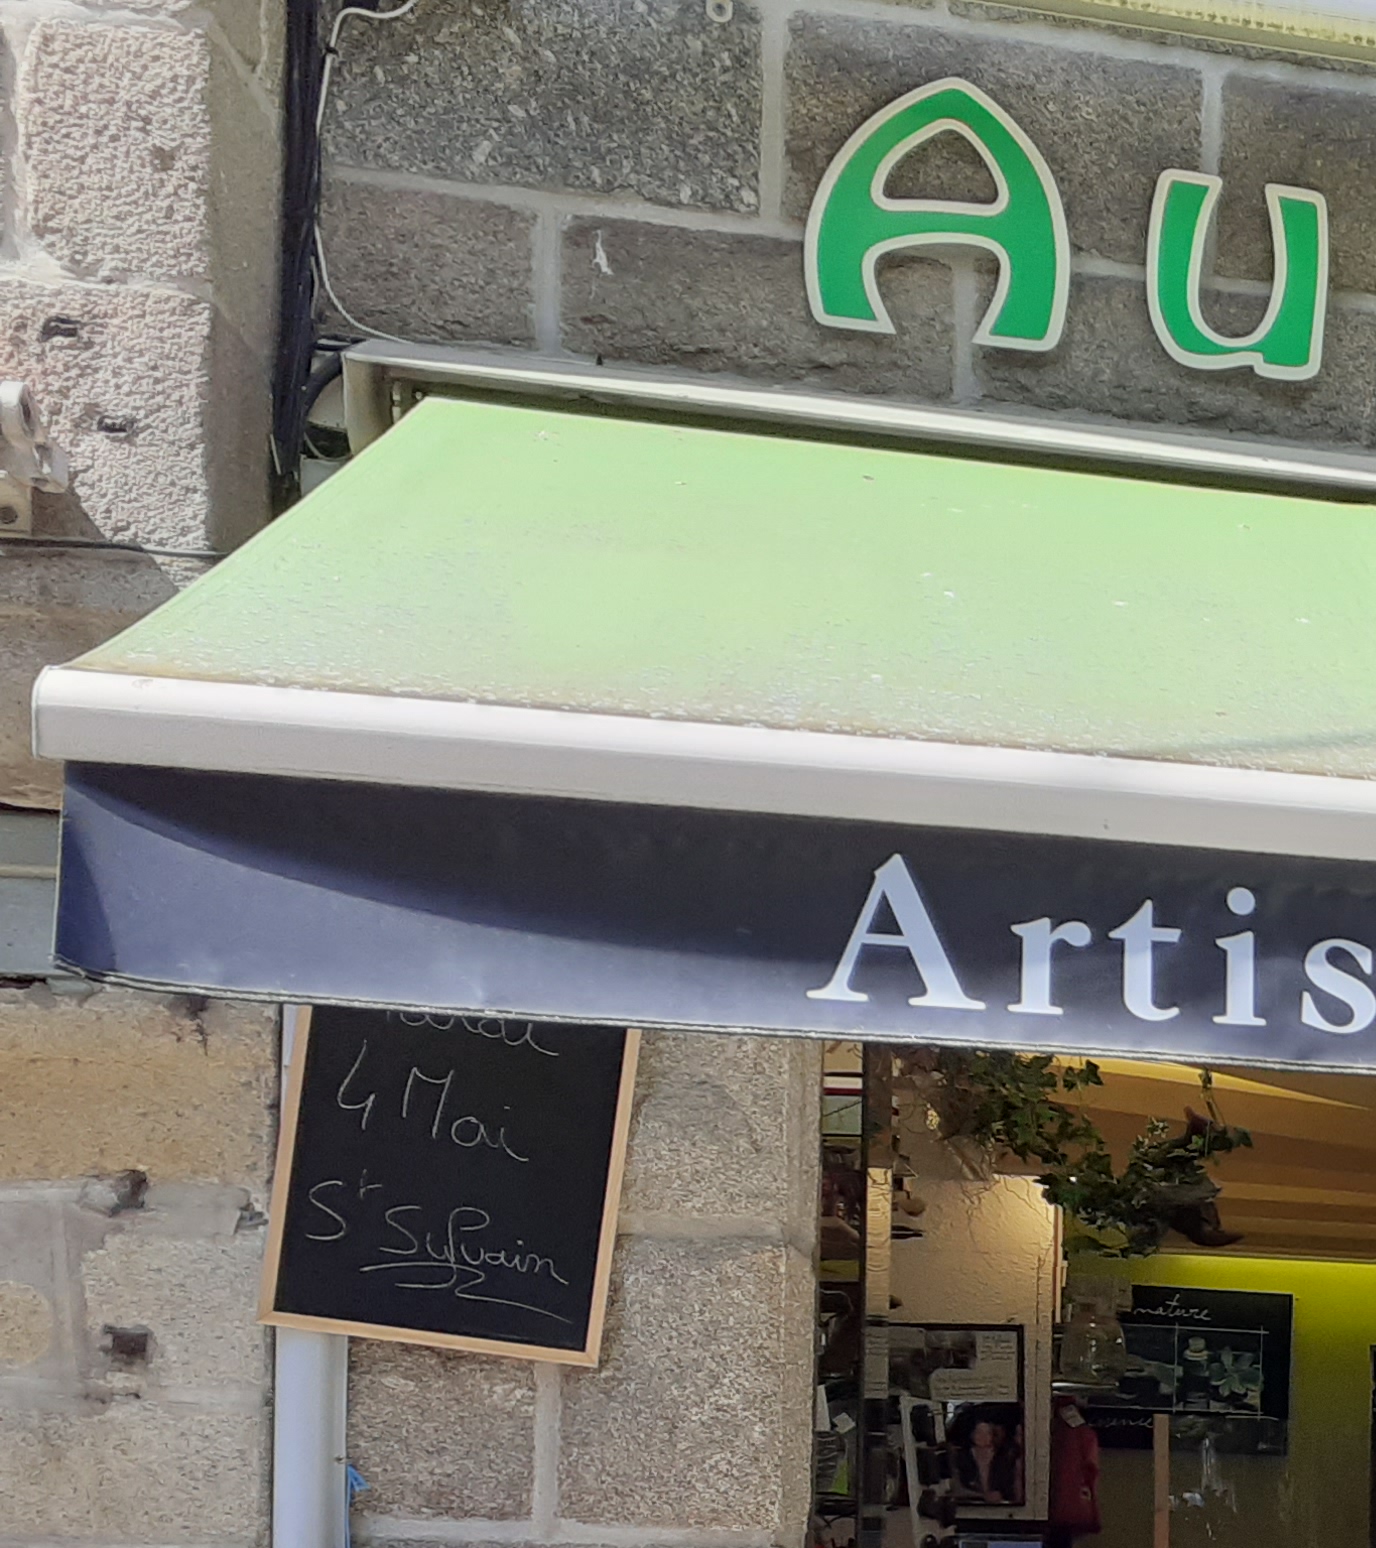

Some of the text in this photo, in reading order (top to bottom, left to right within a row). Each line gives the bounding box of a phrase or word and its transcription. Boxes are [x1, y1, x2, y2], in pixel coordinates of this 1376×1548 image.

[804, 76, 1329, 381] Au
[337, 1039, 530, 1163] 4 Mai
[306, 1168, 383, 1241] St
